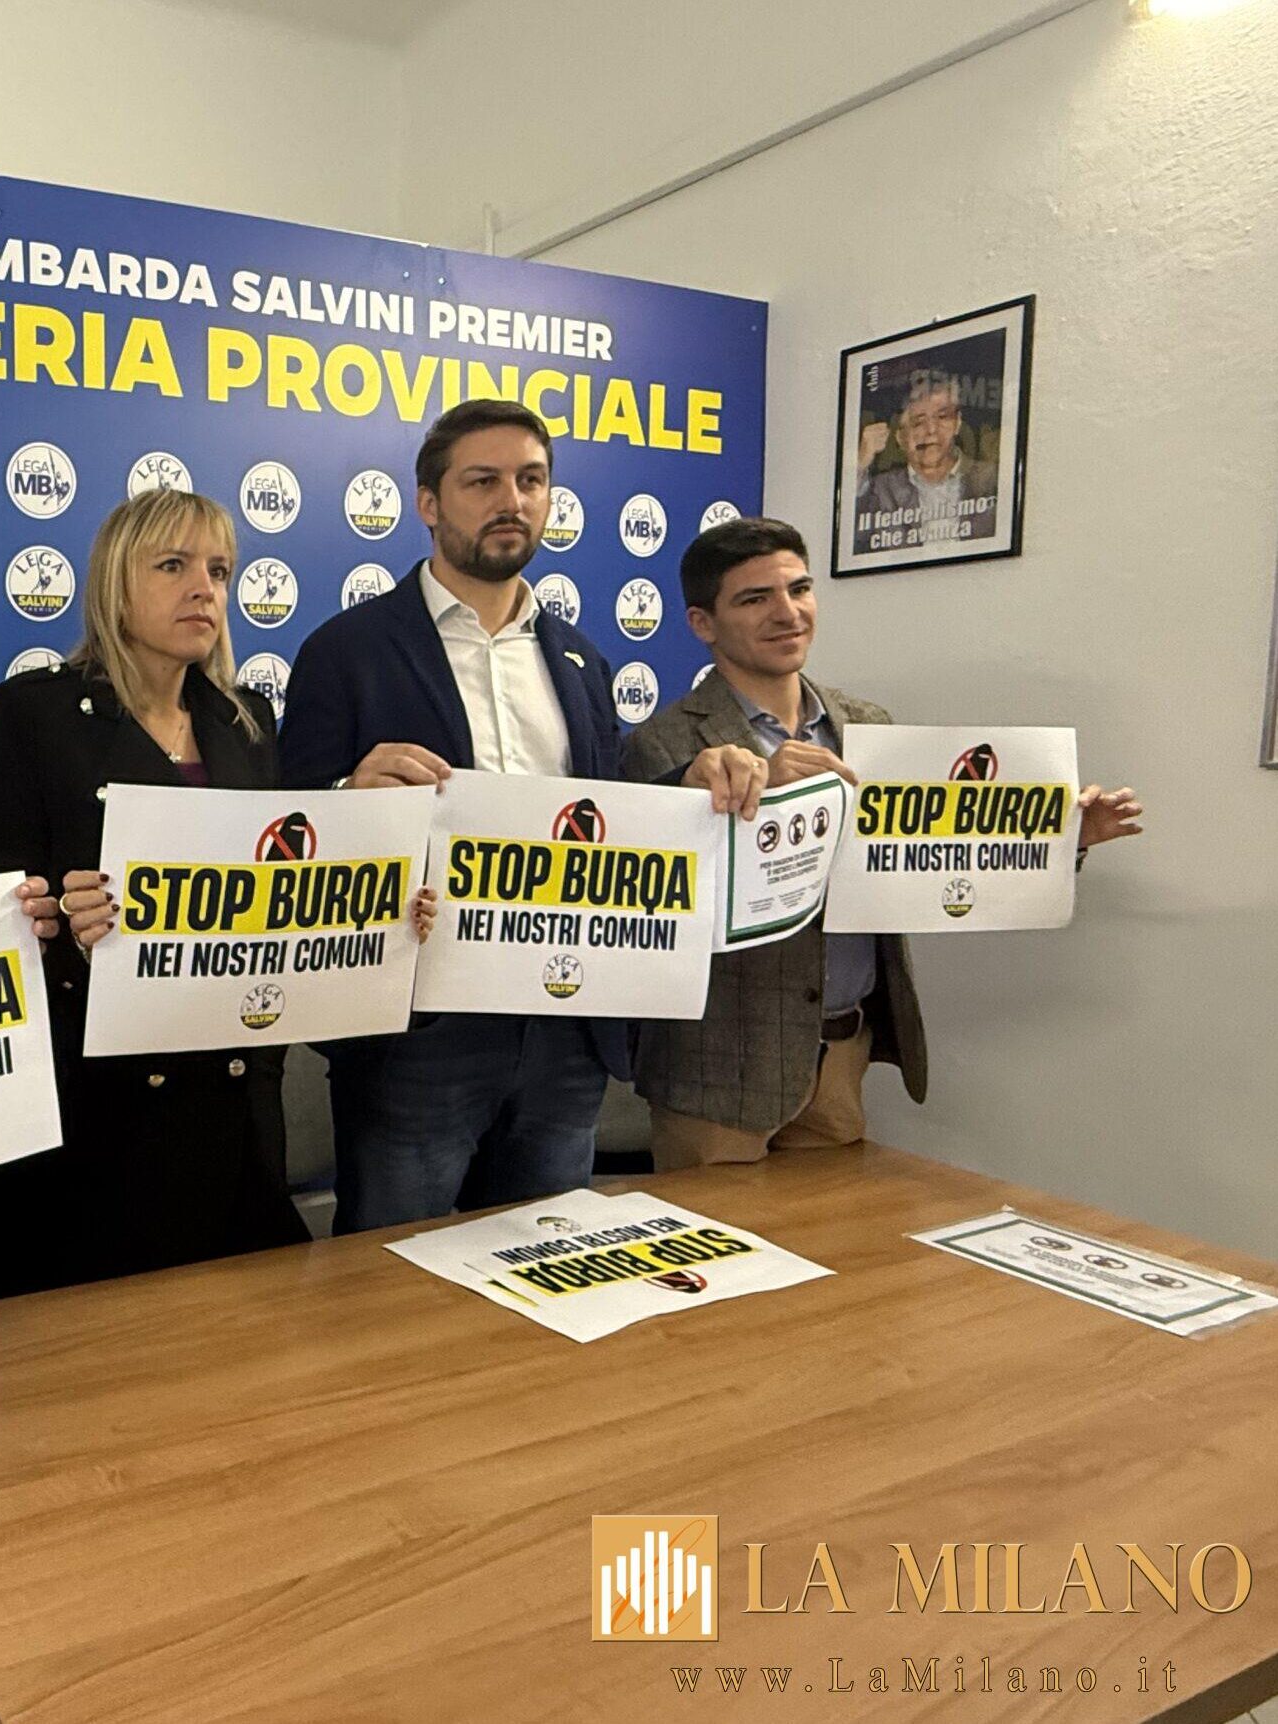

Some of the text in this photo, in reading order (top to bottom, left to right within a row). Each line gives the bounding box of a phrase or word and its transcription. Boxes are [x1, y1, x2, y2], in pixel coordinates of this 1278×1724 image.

[231, 271, 415, 337] SALVINI
[429, 301, 613, 361] PREMIER
[208, 328, 723, 454] PROVINCIALE
[17, 460, 50, 473] LEGA
[136, 458, 182, 482] LEGA
[14, 472, 53, 496] MB
[249, 477, 277, 490] LEGA
[354, 475, 393, 499] LEGA
[247, 490, 279, 512] MB
[627, 509, 649, 521] LEGA
[625, 520, 650, 538] MB
[870, 530, 902, 549] che
[15, 552, 65, 576] LEGA
[246, 564, 290, 586] LEGA
[351, 579, 377, 591] LEGA
[623, 583, 656, 603] LEGA
[18, 595, 63, 607] SALVINI
[248, 604, 288, 616] SALVINI
[245, 669, 272, 681] LEGA
[621, 677, 643, 688] LEGA
[617, 687, 642, 705] MB
[857, 785, 1063, 840] STOP BURQA
[866, 842, 1050, 872] NEI NOSTRI COMUNI
[448, 840, 691, 915] STOP BURQA
[125, 861, 402, 931] STOP BURQA
[457, 908, 677, 951] NEI NOSTRI COMUNI
[136, 932, 385, 978] NEI NOSTRI COMUNI
[642, 1217, 690, 1231] NEI
[573, 1224, 657, 1249] NOSTRI
[491, 1239, 585, 1265] COMUNI
[510, 1229, 753, 1293] STOP BURQA
